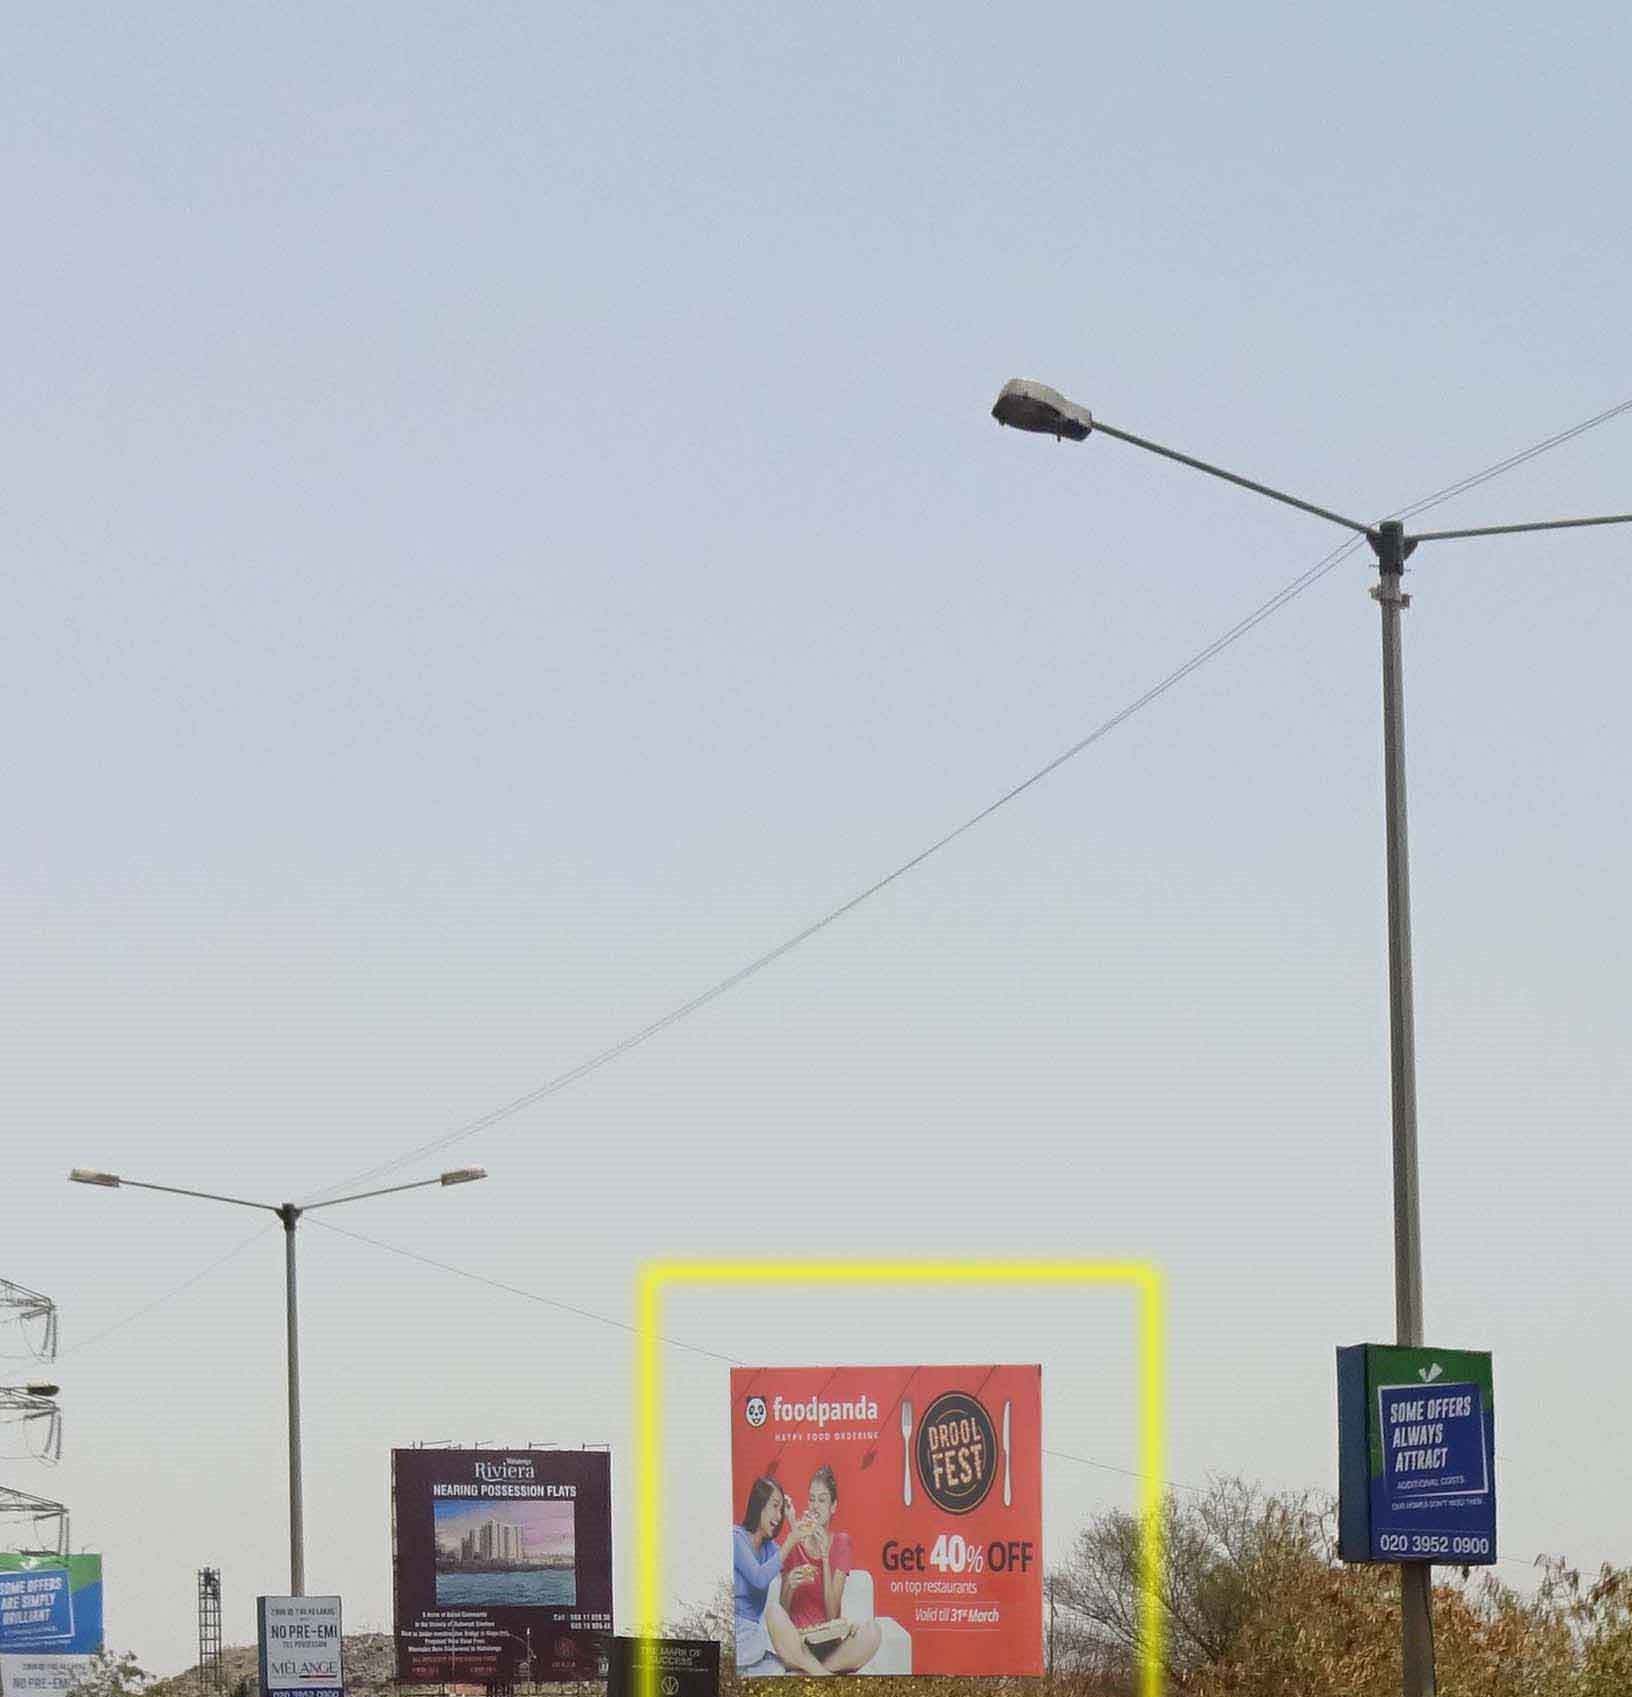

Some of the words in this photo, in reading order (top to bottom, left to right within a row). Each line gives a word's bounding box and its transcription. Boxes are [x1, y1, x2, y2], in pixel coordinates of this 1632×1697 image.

[773, 1395, 878, 1427] foodpanda
[1390, 1401, 1425, 1423] SOME
[1427, 1396, 1471, 1420] OFFERS
[928, 1417, 981, 1450] DROOL
[1392, 1424, 1443, 1448] ALWAYS
[474, 1461, 535, 1481] Riviera
[932, 1444, 982, 1489] FEST
[1395, 1448, 1448, 1472] ATTRACT
[481, 1485, 544, 1497] POSSESSION
[547, 1485, 577, 1497] FLATS
[882, 1541, 925, 1571] Get
[930, 1535, 984, 1572] 40%
[988, 1542, 1033, 1572] OFF
[1380, 1534, 1408, 1551] 020
[1412, 1535, 1449, 1552] 3952
[1453, 1537, 1489, 1554] 0900
[891, 1582, 903, 1593] on
[906, 1581, 922, 1596] top
[923, 1580, 977, 1594] restaurants
[968, 1608, 999, 1622] March
[271, 1625, 286, 1639] NO
[289, 1624, 337, 1639] PRE-EMI
